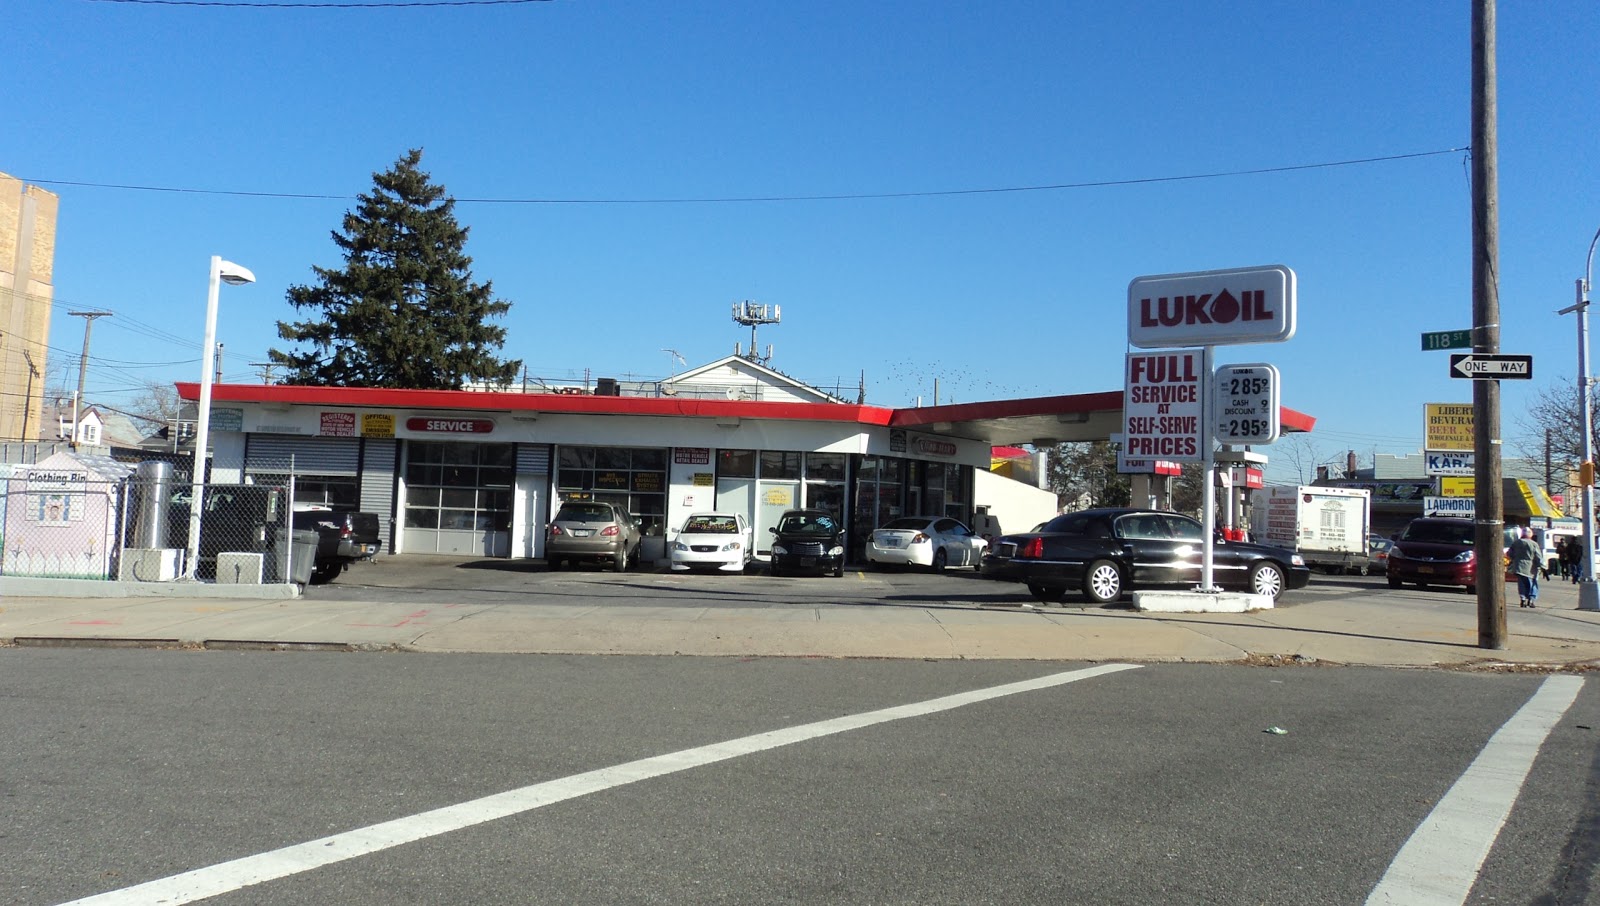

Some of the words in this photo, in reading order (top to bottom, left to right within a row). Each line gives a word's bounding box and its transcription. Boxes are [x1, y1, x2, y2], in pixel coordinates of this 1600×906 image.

[1141, 288, 1273, 328] LUKOIL
[1429, 334, 1450, 348] 118
[1454, 332, 1463, 340] ST
[1131, 355, 1197, 383] FULL
[1465, 361, 1488, 372] ONE
[1501, 361, 1525, 372] WAY
[1132, 385, 1197, 403] SERVICE
[1231, 378, 1260, 395] 285
[1157, 403, 1171, 414] AT
[322, 413, 354, 422] REGISTERED
[1129, 417, 1197, 434] SELF-SERVE
[426, 421, 474, 432] SERVICE
[1230, 419, 1259, 436] 295
[1429, 426, 1457, 434] BEER
[1128, 437, 1197, 456] PRICES
[28, 472, 67, 485] Clothing
[71, 474, 86, 482] Bin
